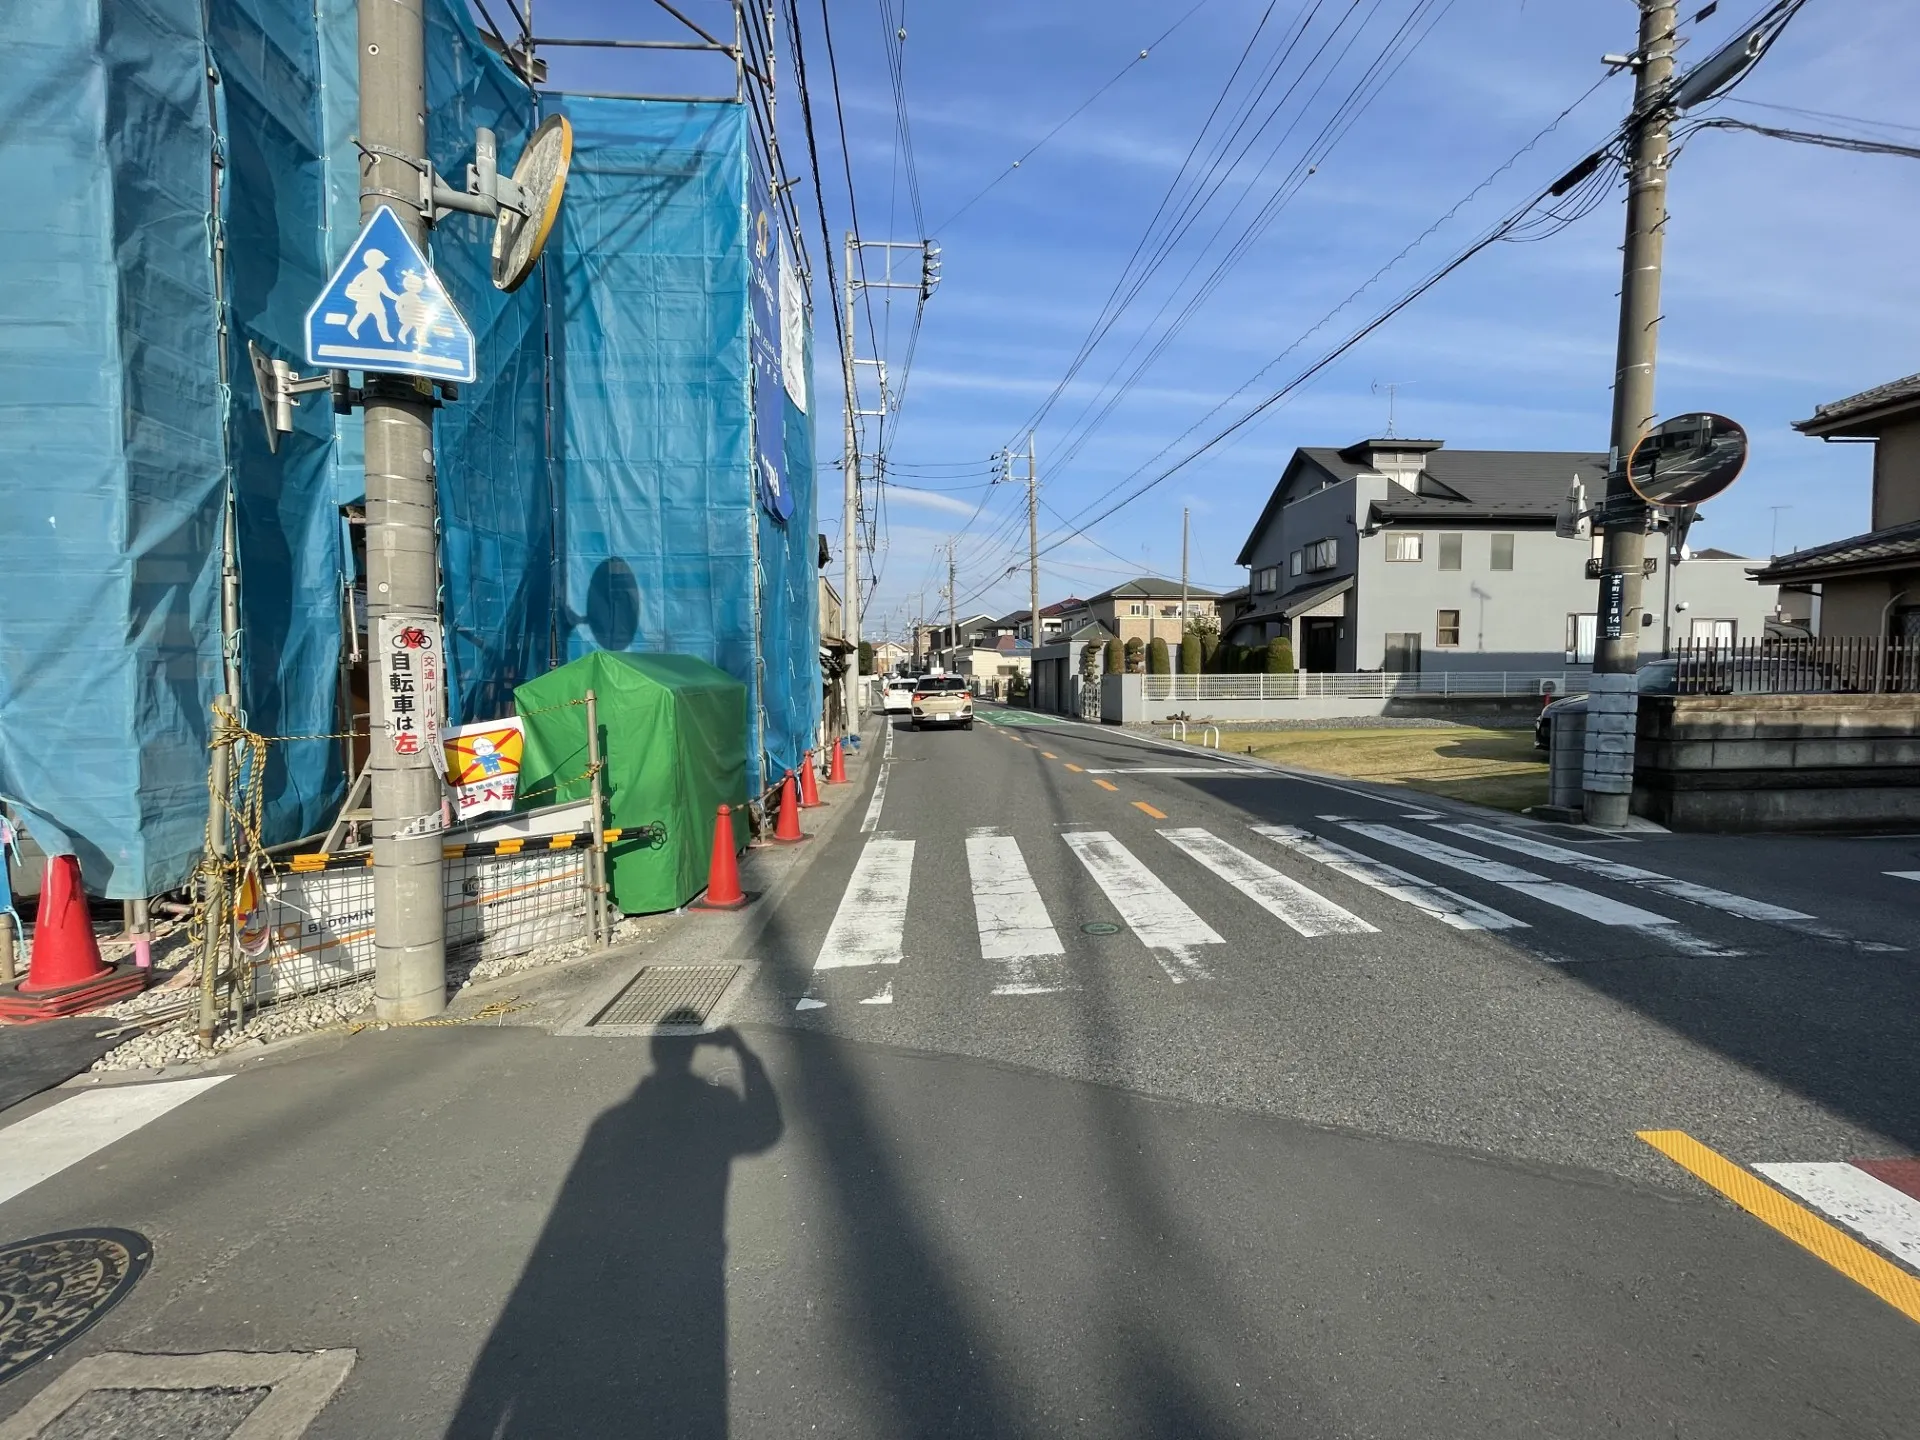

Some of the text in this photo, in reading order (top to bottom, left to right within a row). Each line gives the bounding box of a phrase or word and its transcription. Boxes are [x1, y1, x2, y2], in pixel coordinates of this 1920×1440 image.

[389, 650, 419, 753] 自転車は左
